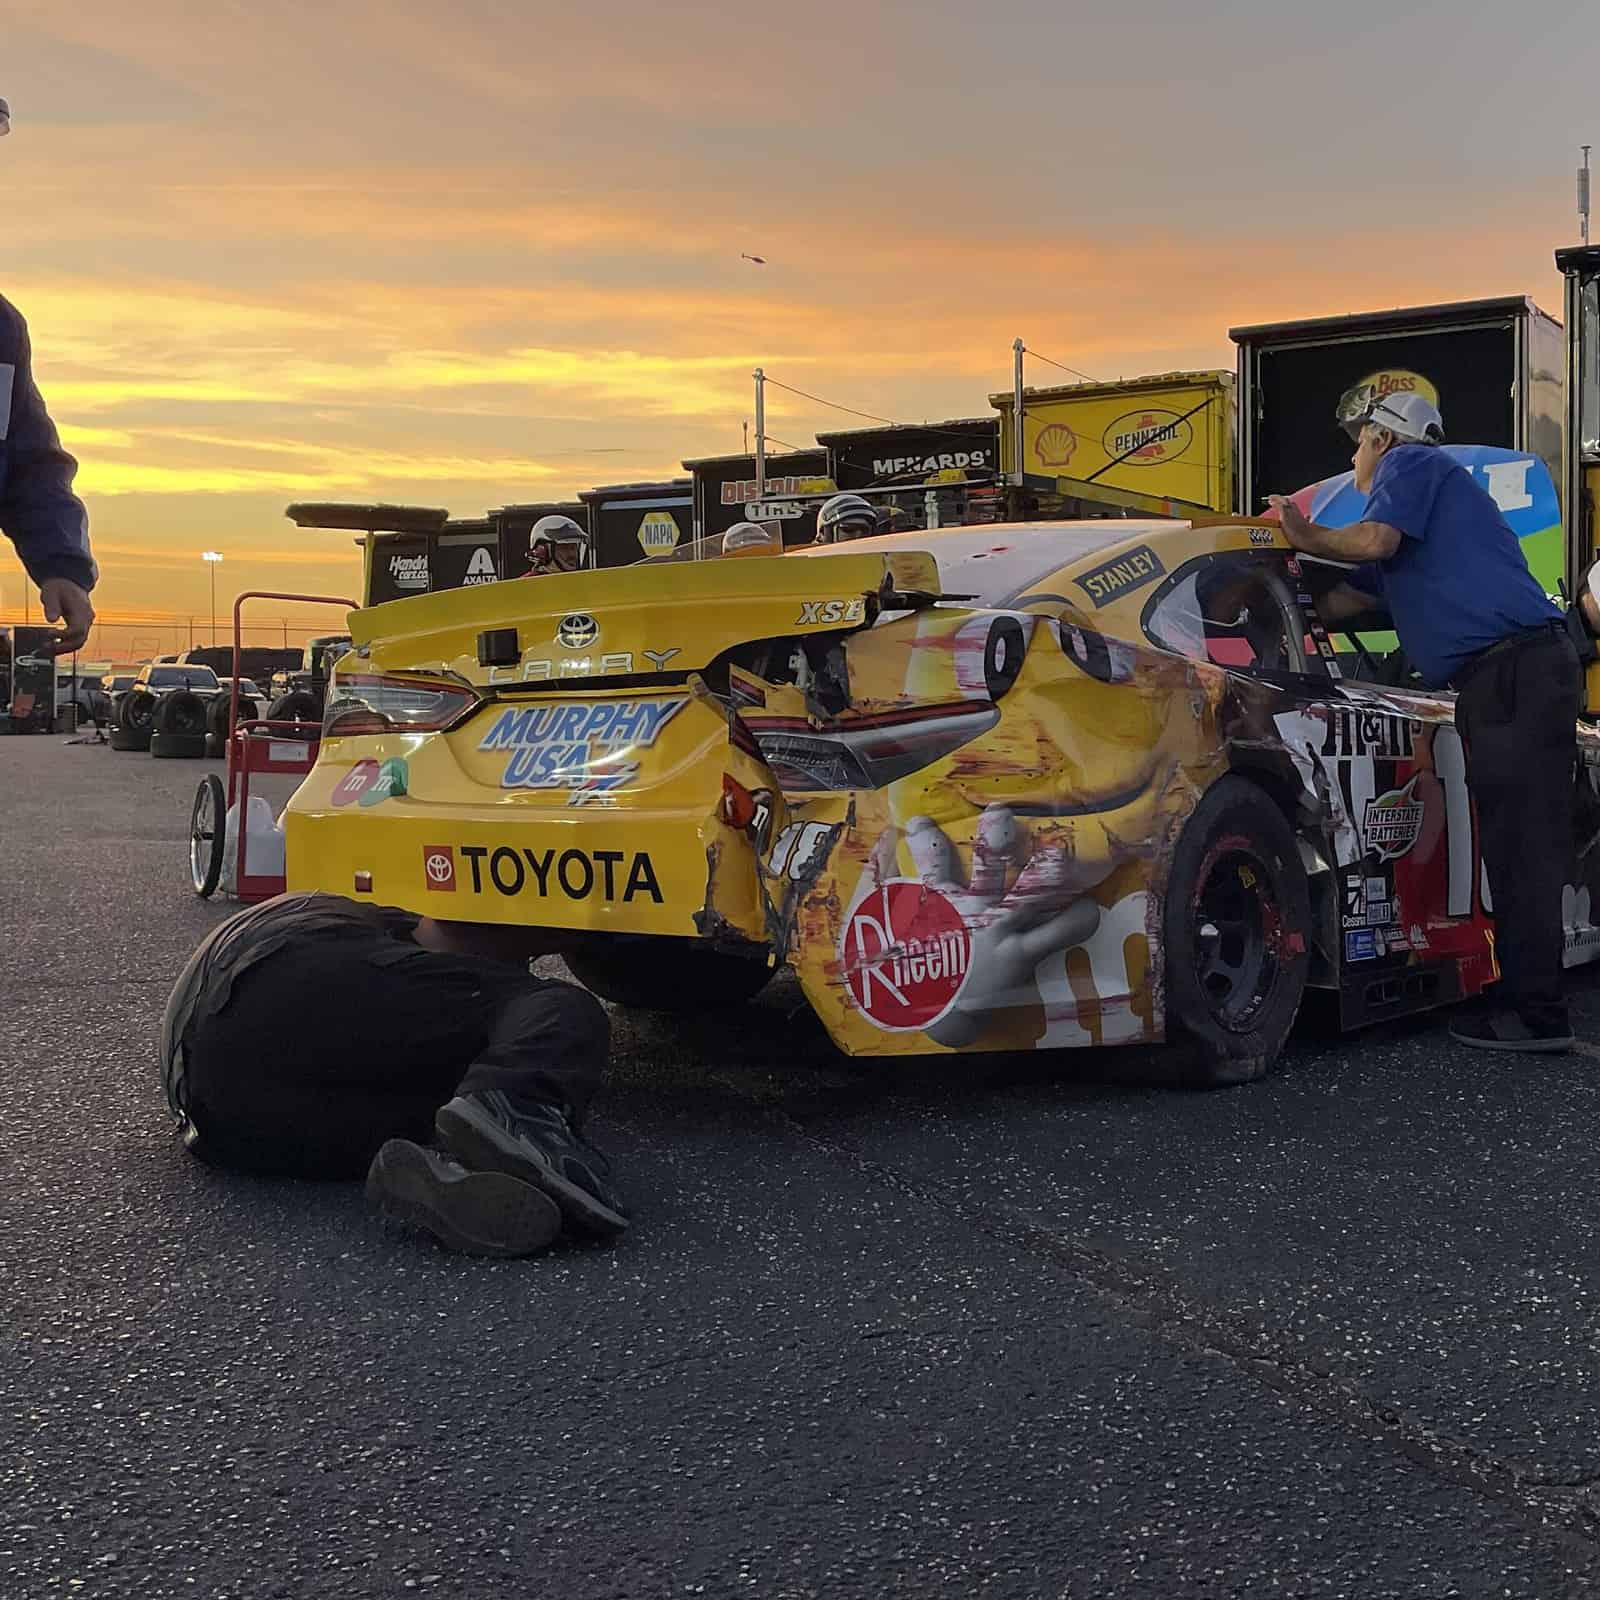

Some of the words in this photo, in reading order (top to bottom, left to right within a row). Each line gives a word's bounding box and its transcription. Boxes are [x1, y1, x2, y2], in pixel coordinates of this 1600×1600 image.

[1378, 374, 1416, 394] Bass
[1114, 424, 1179, 452] PENNZOIL
[873, 450, 985, 474] MENARDS
[643, 523, 674, 545] NAPA
[463, 574, 498, 585] AXALTA
[1085, 551, 1156, 598] STANLEY
[796, 600, 862, 625] XSE
[487, 647, 683, 686] CAMRY
[479, 696, 689, 750] MURPHY
[501, 743, 594, 788] USA
[1367, 807, 1421, 824] INTERSTATE
[1370, 824, 1417, 842] BATTERIES
[460, 846, 665, 904] TOYOTA
[853, 885, 966, 1010] Rheem
